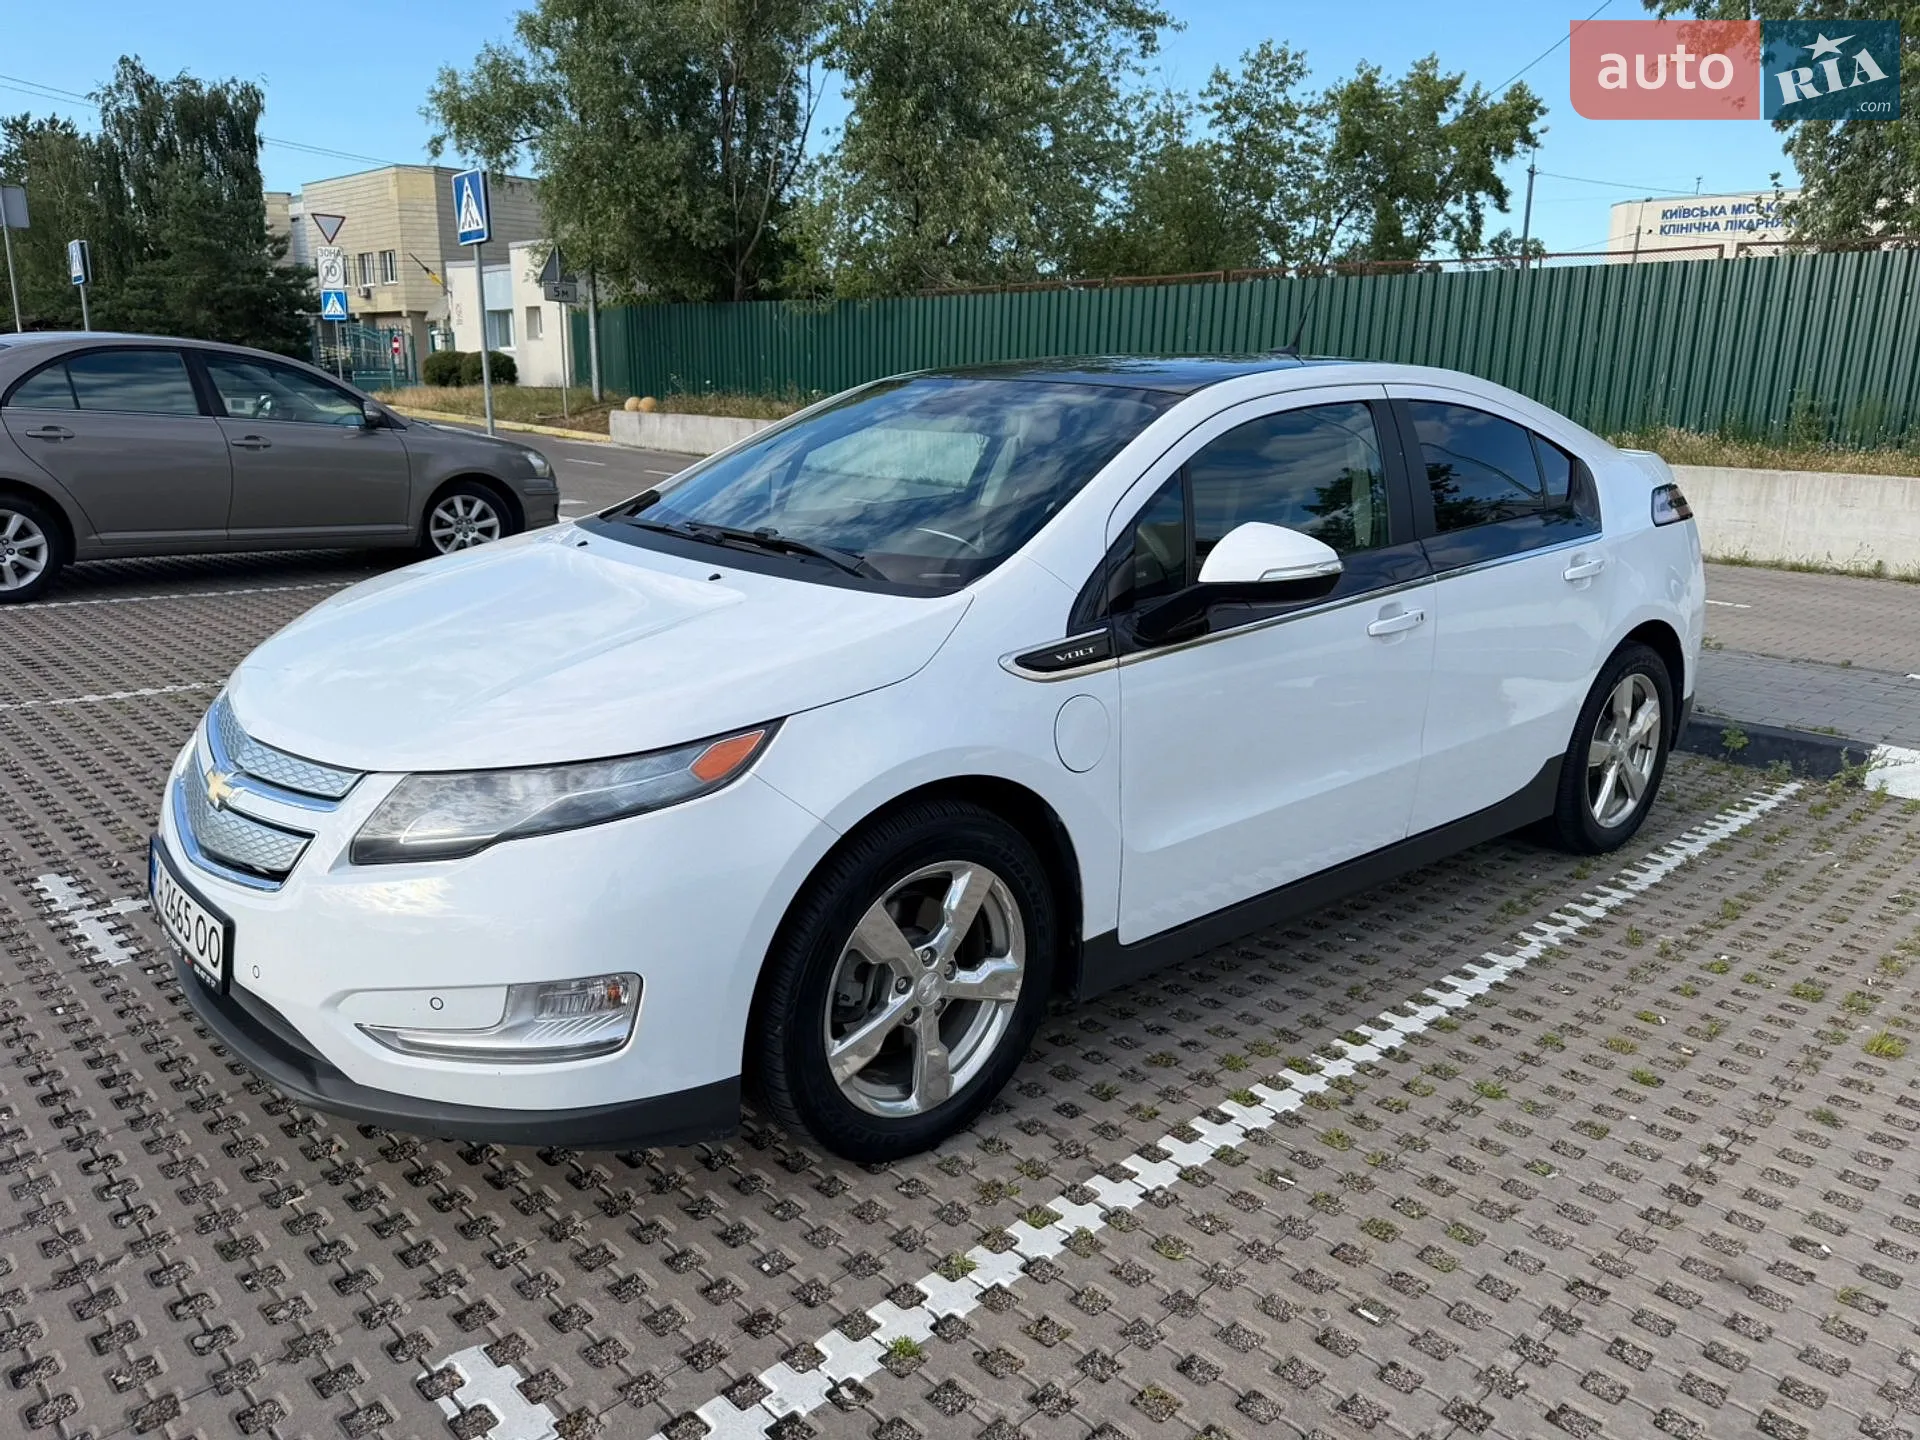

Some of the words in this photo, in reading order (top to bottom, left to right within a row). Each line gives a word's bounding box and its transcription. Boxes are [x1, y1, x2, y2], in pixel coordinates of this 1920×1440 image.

[1661, 205, 1727, 220] КИЇВСЬКА
[1659, 221, 1720, 235] КЛІНІЧНА
[1724, 217, 1784, 231] ЛІКАРНЯ
[318, 247, 342, 257] ЗОНА
[325, 265, 338, 277] 10
[553, 286, 561, 297] 5
[1055, 645, 1097, 662] VOLT
[165, 878, 191, 942] 2665
[195, 914, 220, 968] OO
